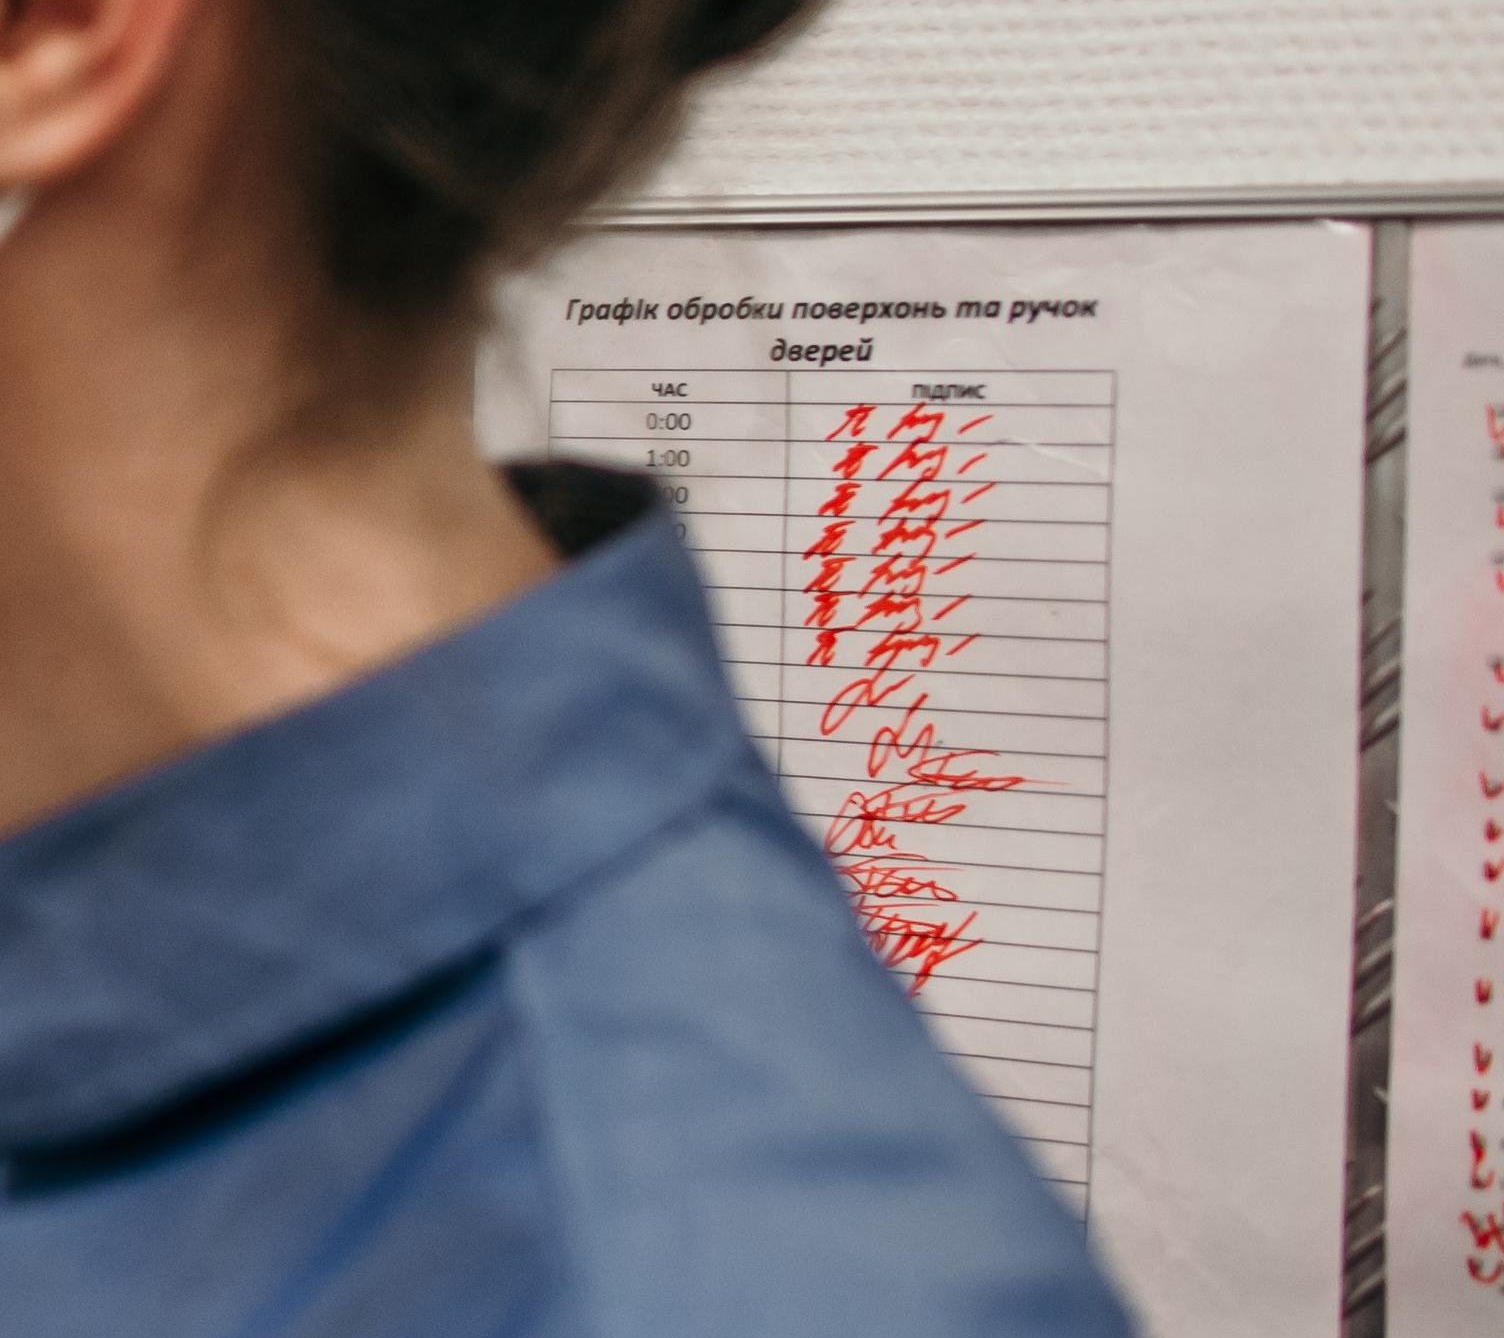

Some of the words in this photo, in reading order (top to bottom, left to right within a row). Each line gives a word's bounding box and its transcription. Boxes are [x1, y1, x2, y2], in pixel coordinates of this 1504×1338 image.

[565, 297, 660, 326] Графік
[667, 296, 784, 326] обробки
[792, 300, 947, 324] поверхонь
[955, 299, 1001, 319] та
[1007, 299, 1099, 324] ручок
[769, 338, 874, 367] дверей
[651, 382, 689, 398] ЧАС
[646, 412, 692, 431] 0:00
[646, 449, 691, 467] 1:00
